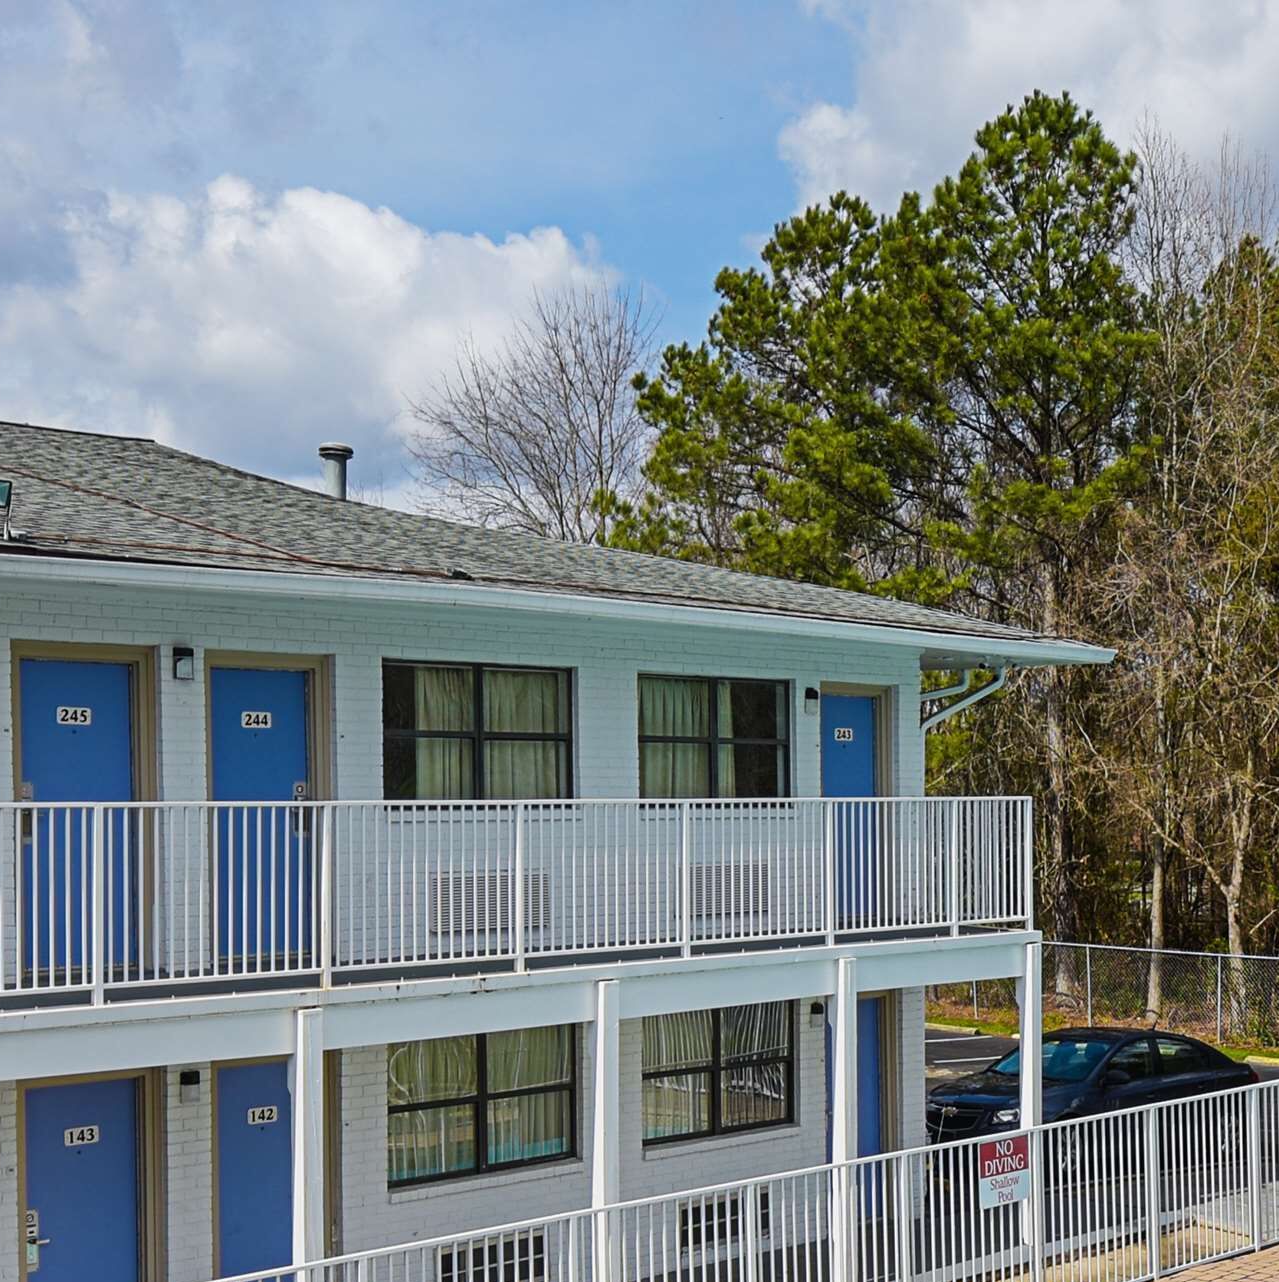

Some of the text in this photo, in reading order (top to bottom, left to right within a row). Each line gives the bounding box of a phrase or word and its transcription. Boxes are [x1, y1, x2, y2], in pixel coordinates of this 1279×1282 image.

[60, 708, 88, 723] 245
[244, 713, 269, 727] 244
[836, 729, 852, 740] 243
[251, 1108, 274, 1123] 142
[69, 1128, 96, 1145] 143
[995, 1139, 1014, 1158] NO
[984, 1153, 1025, 1177] DIVING
[990, 1175, 1020, 1191] Shallow
[998, 1188, 1014, 1203] Pool
